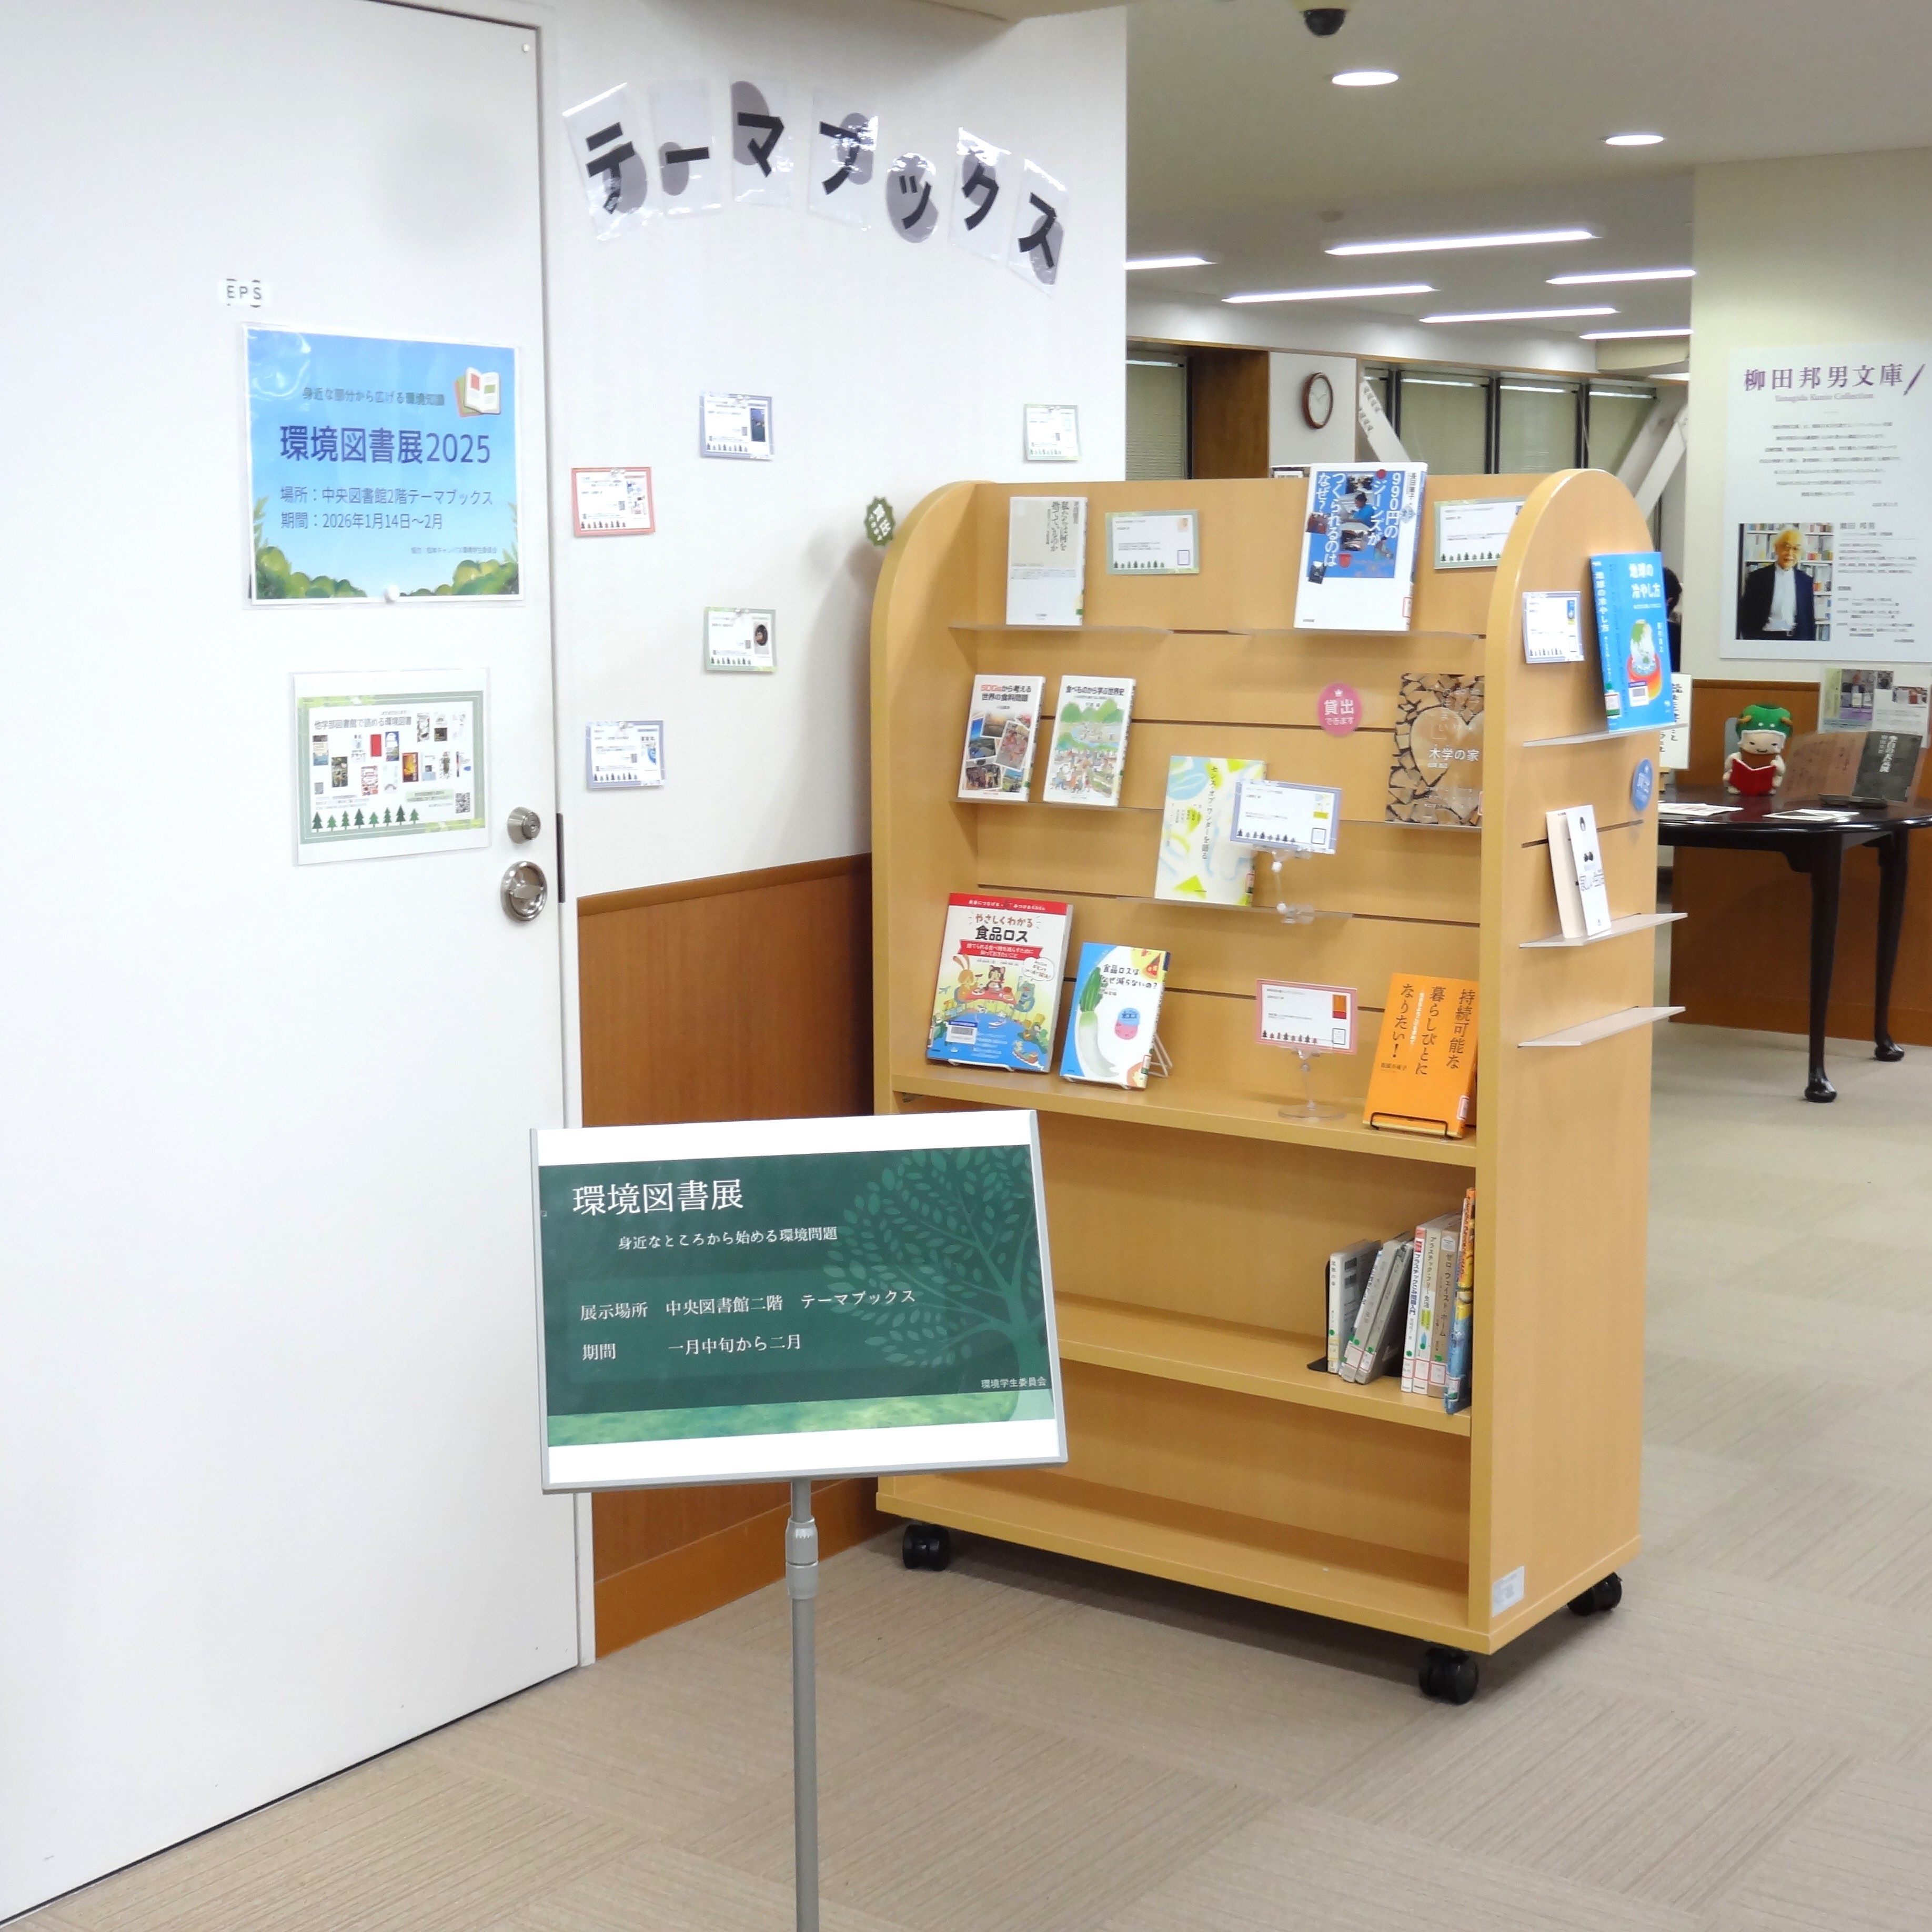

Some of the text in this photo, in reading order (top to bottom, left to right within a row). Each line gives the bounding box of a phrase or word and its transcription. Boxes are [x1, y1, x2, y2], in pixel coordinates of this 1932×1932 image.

[226, 285, 261, 300] EPS
[1744, 363, 1903, 391] 柳田邦男文庫
[279, 425, 491, 464] 環境図書展2025
[1367, 479, 1388, 546] ジーンズが
[1384, 472, 1401, 538] 990円の
[1324, 699, 1354, 716] 貸出
[1325, 717, 1354, 726] できます
[975, 913, 1033, 928] やさしくわかる
[975, 925, 1028, 942] 食品ロス
[1103, 963, 1140, 975] 食品ロスは
[1392, 983, 1414, 1058] なりたい！
[1415, 986, 1446, 1075] 暮らしびとに
[1446, 988, 1476, 1070] 持続可能な
[572, 1179, 744, 1216] 環境図書展
[618, 1226, 838, 1252] 身近なところから始める環境問題
[580, 1289, 916, 1322] 展示場所 中央図書館二階 テーマブックス
[582, 1334, 801, 1361] 期間 一月中旬から二月
[980, 1376, 1048, 1389] 環境学生委員会
